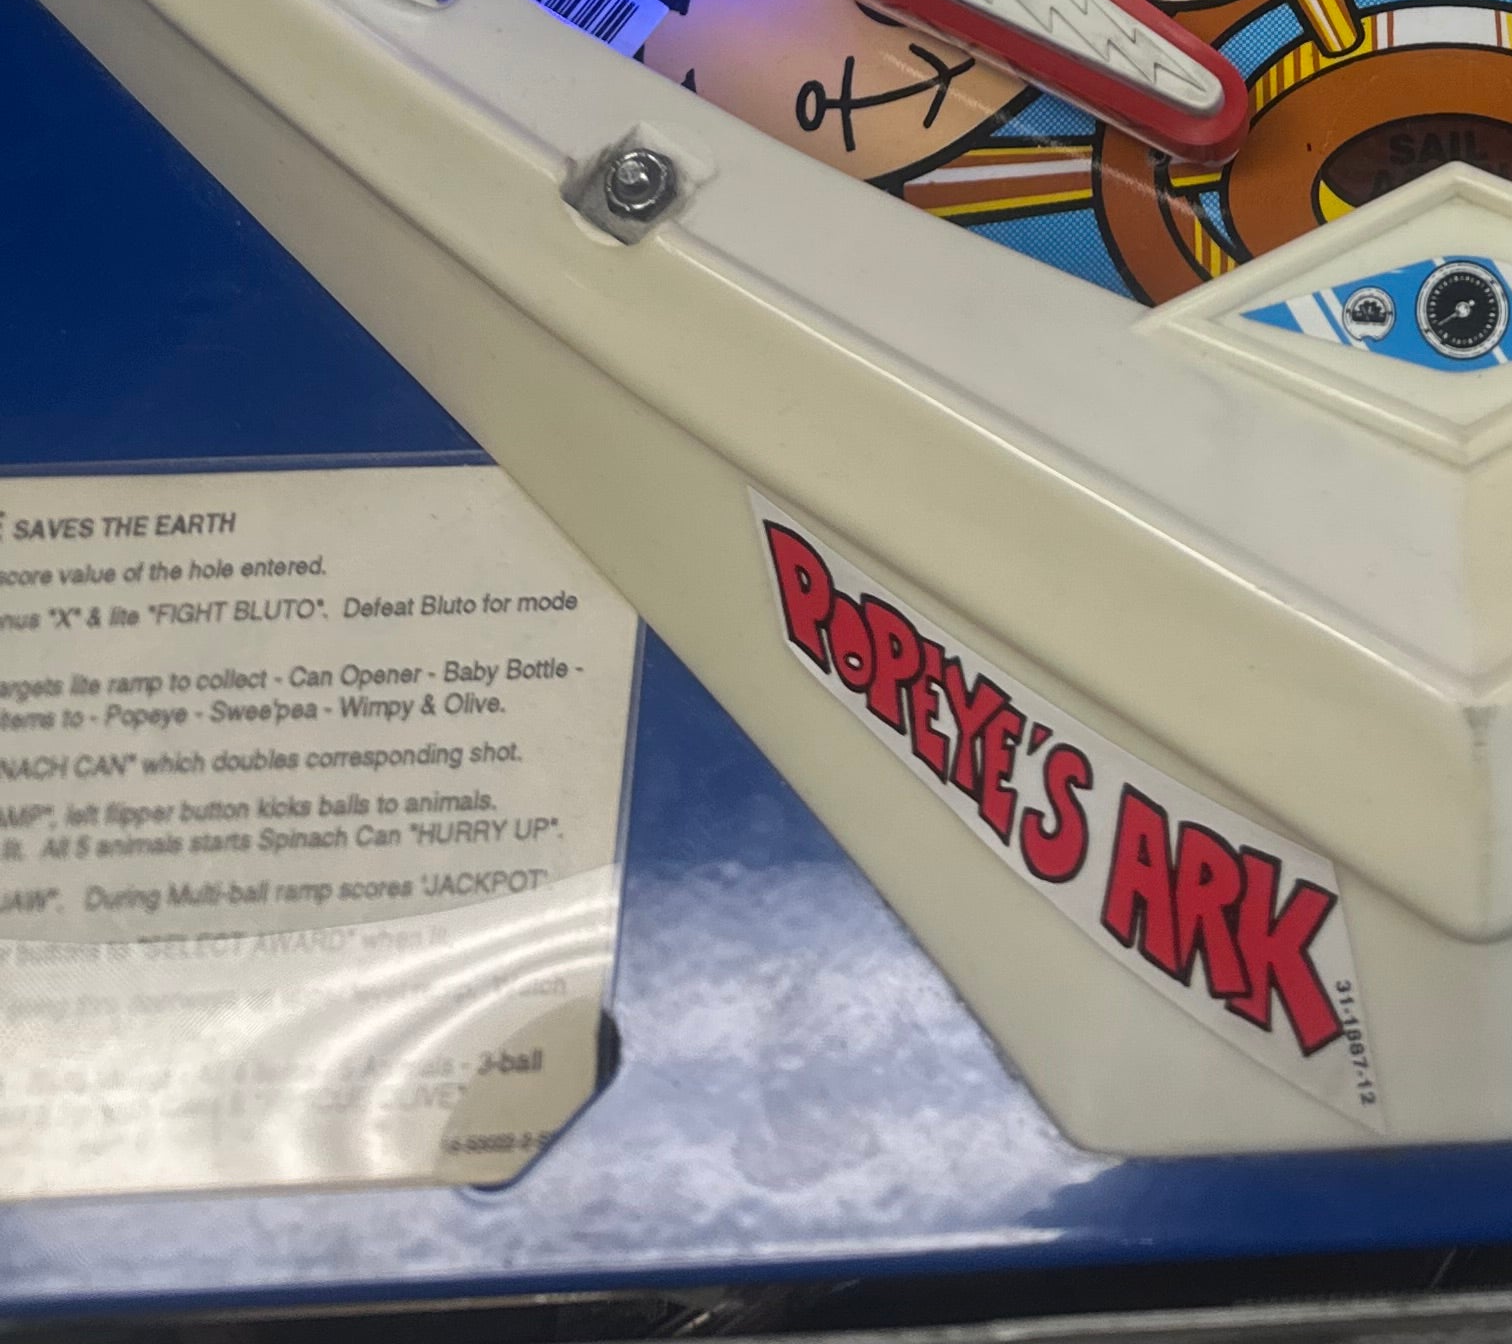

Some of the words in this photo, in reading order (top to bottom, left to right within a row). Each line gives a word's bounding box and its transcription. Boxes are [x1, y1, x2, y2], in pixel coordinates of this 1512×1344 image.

[1389, 129, 1488, 162] SAIL
[13, 516, 95, 541] SAVES
[102, 515, 149, 537] THE
[154, 512, 237, 536] EARTH
[0, 566, 52, 587] score
[59, 564, 116, 586] value
[123, 561, 144, 583] of
[149, 560, 183, 582] the
[188, 559, 235, 581] hole
[240, 554, 327, 578] entered.
[86, 607, 102, 630] &
[109, 605, 140, 627] lite
[148, 600, 229, 624] "FIGHT
[343, 595, 415, 620] Defeat
[420, 593, 477, 617] Bluto
[482, 592, 513, 614] for
[517, 589, 579, 612] mode
[70, 673, 101, 697] lite
[106, 673, 163, 698] ramp
[169, 671, 192, 693] to
[195, 667, 268, 692] collect
[288, 664, 334, 688] Can
[339, 663, 422, 691] Opener
[443, 659, 500, 688] Baby
[505, 656, 569, 681] Bottle
[62, 709, 84, 730] to
[104, 703, 188, 731] Popeye
[209, 697, 319, 727] Swee'pea
[338, 694, 415, 722] Wimpy
[420, 692, 437, 716] &
[443, 690, 507, 715] Olive.
[73, 752, 138, 778] CAN"
[142, 750, 206, 775] which
[211, 747, 300, 772] doubles
[305, 742, 464, 771] corresponding
[468, 740, 523, 764] shot.
[178, 799, 250, 822] button
[256, 795, 312, 819] kicks
[317, 793, 371, 816] balls
[377, 792, 400, 814] to
[404, 788, 498, 814] animals.
[763, 520, 1094, 883] POPEYE'S
[1100, 783, 1345, 1057] ARK
[188, 831, 253, 854] starts
[257, 826, 348, 854] Spinach
[355, 823, 402, 848] Can
[408, 818, 507, 845] "HURRY
[83, 883, 162, 914] During
[166, 878, 270, 907] Multi-ball
[274, 880, 333, 904] ramp
[338, 877, 414, 902] scores
